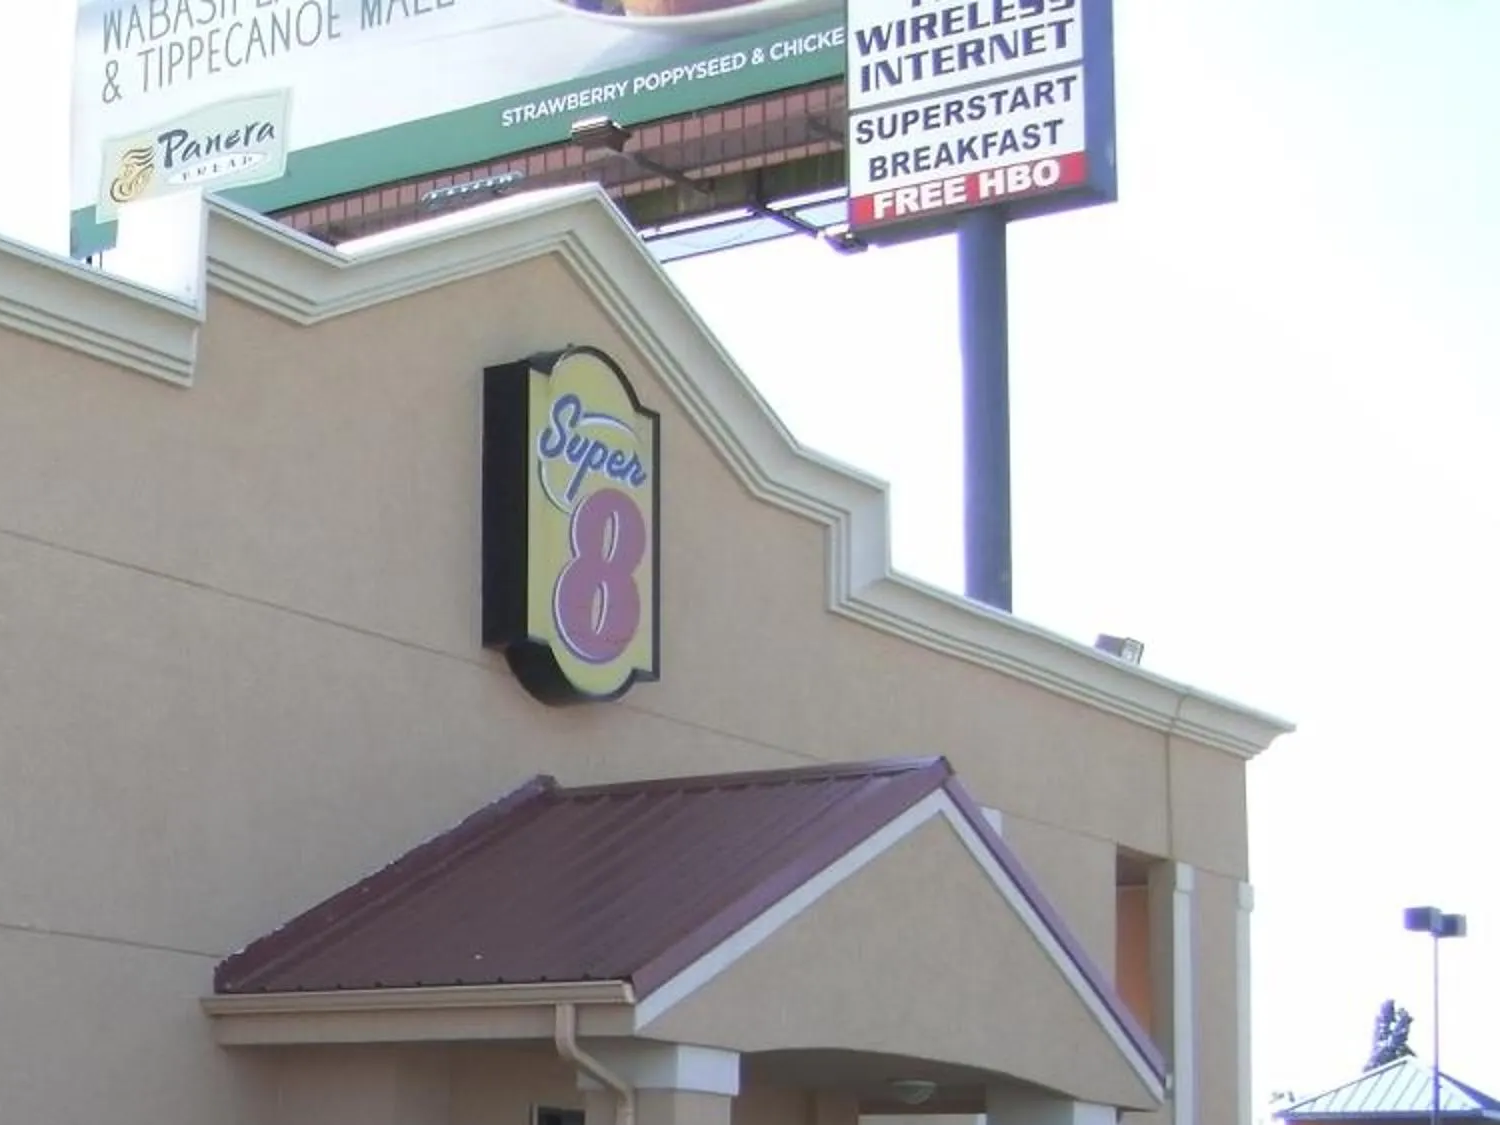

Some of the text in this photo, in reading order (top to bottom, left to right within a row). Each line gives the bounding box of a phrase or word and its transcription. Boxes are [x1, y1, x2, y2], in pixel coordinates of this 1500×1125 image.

[102, 0, 456, 104] & TIPPECANOE MA
[501, 80, 629, 127] STRAWBERRY
[633, 52, 746, 95] POPPYSEED
[751, 47, 765, 65] &
[860, 18, 1074, 94] INTERNET
[157, 121, 275, 169] Panera
[855, 75, 1078, 145] SUPERSTART
[868, 118, 1064, 183] BREAKFAST
[872, 159, 1060, 220] FREE HBO
[537, 393, 648, 504] Super
[552, 487, 648, 665] 8
